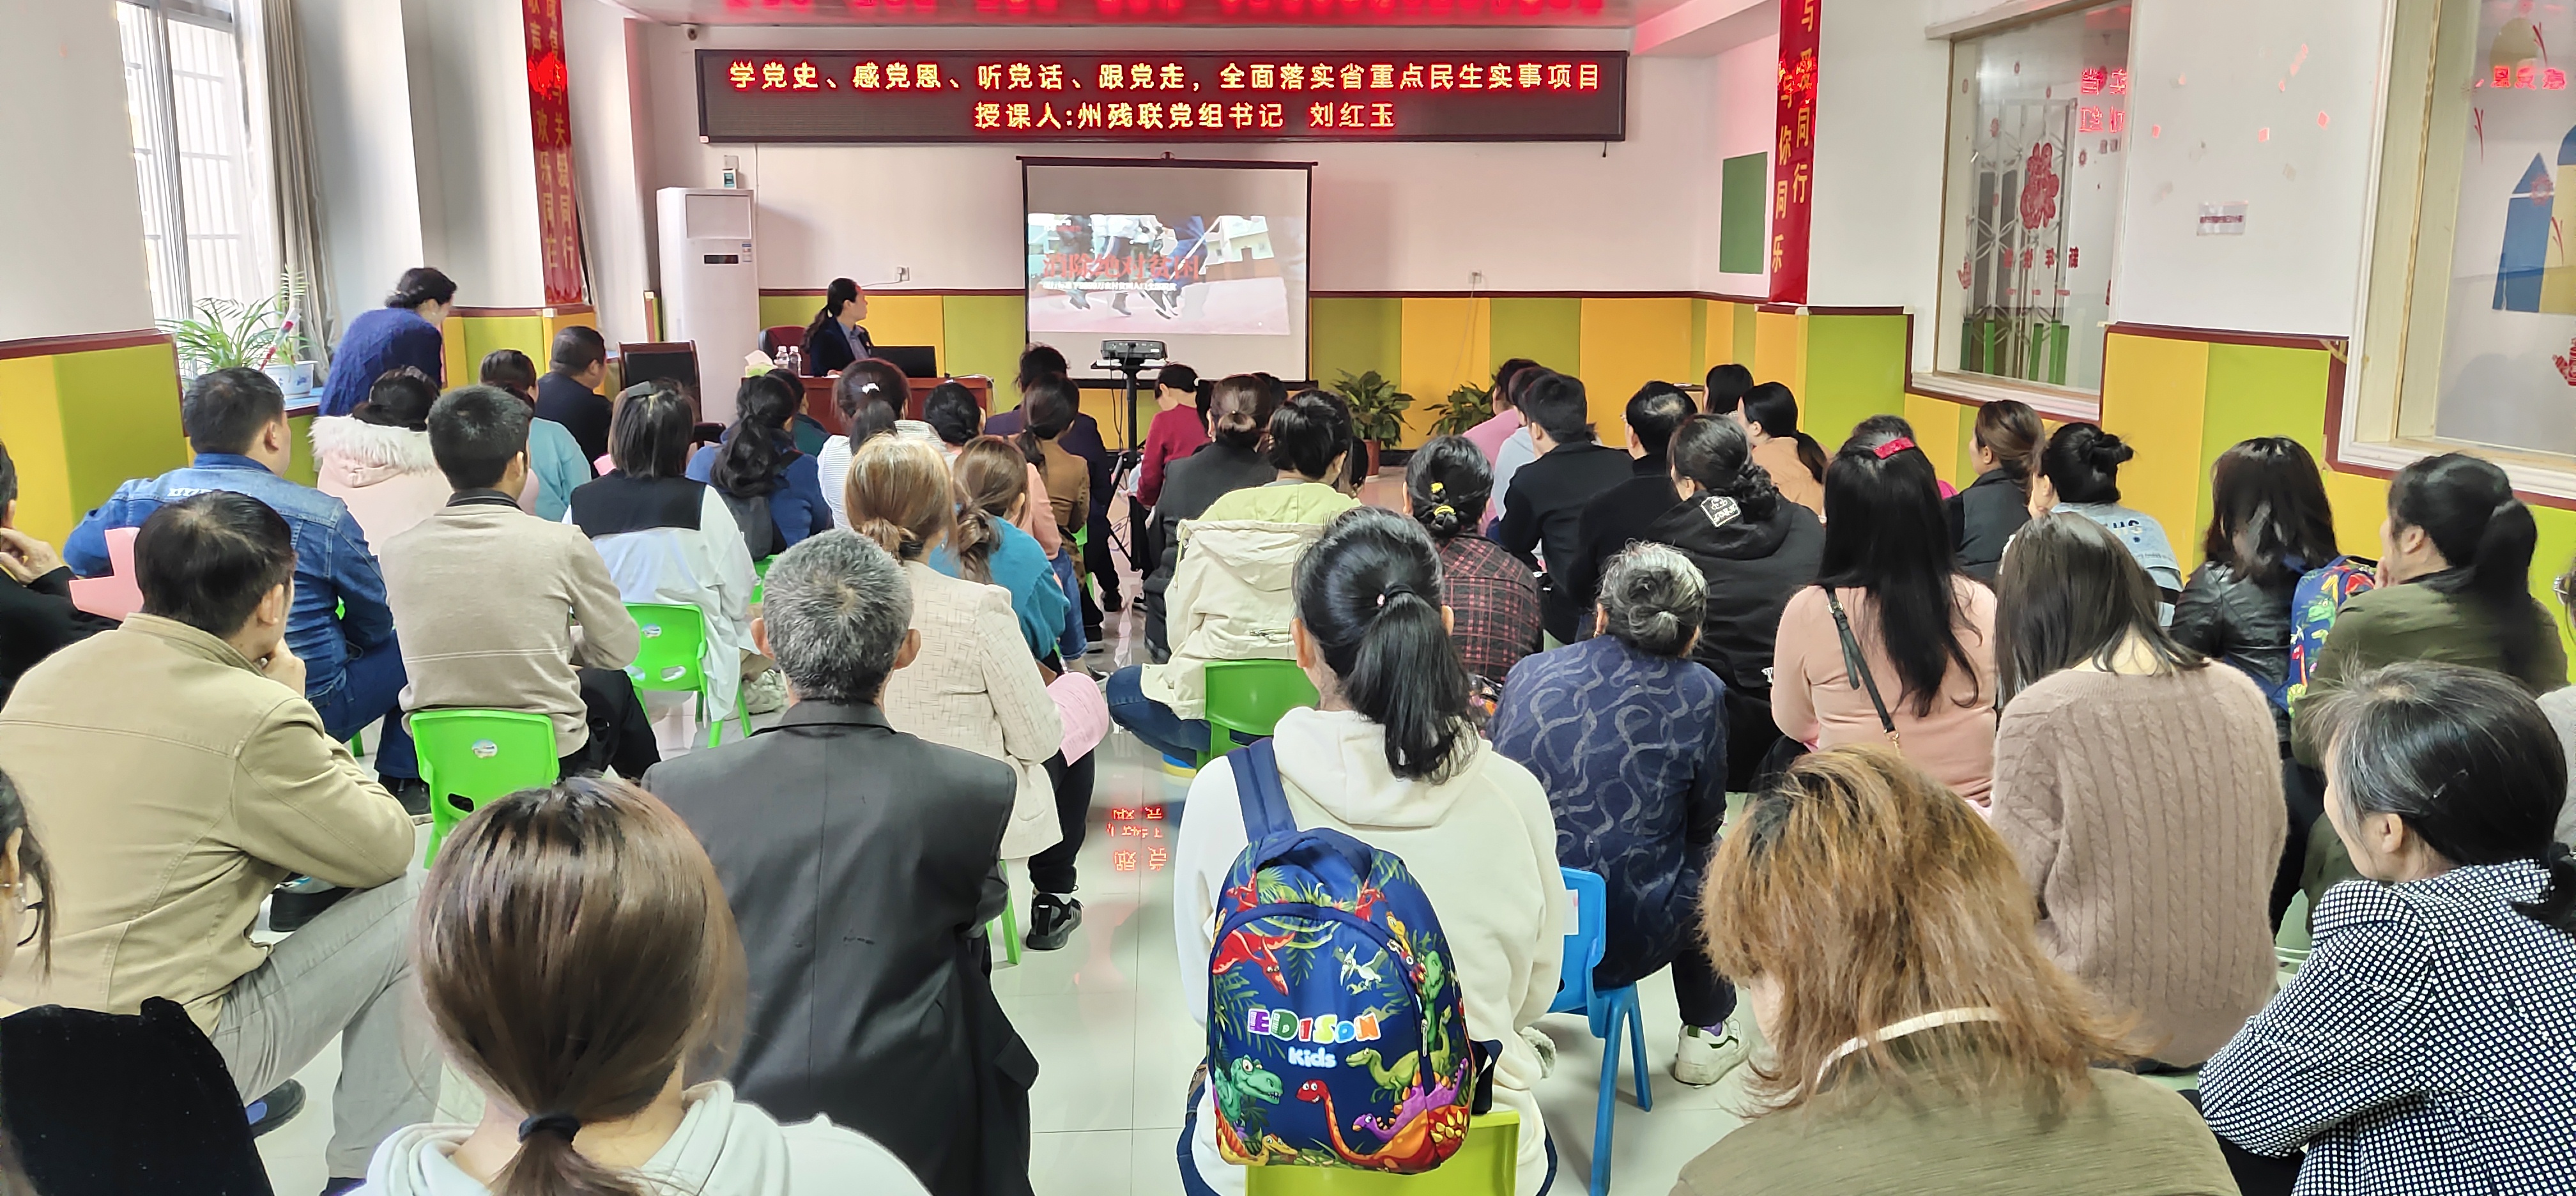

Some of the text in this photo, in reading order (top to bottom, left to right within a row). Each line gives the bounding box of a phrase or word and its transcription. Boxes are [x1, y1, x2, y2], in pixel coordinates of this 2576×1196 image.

[729, 61, 1600, 90] 学党史、感党恩、听党话、跟党走，全面落实省重点民生实事项目
[974, 101, 1395, 129] 授课人:州残联党组书记 刘红玉
[1042, 252, 1199, 280] 消除绝对贫困
[1247, 1008, 1381, 1044] EDISON
[1287, 1046, 1337, 1068] Kids
